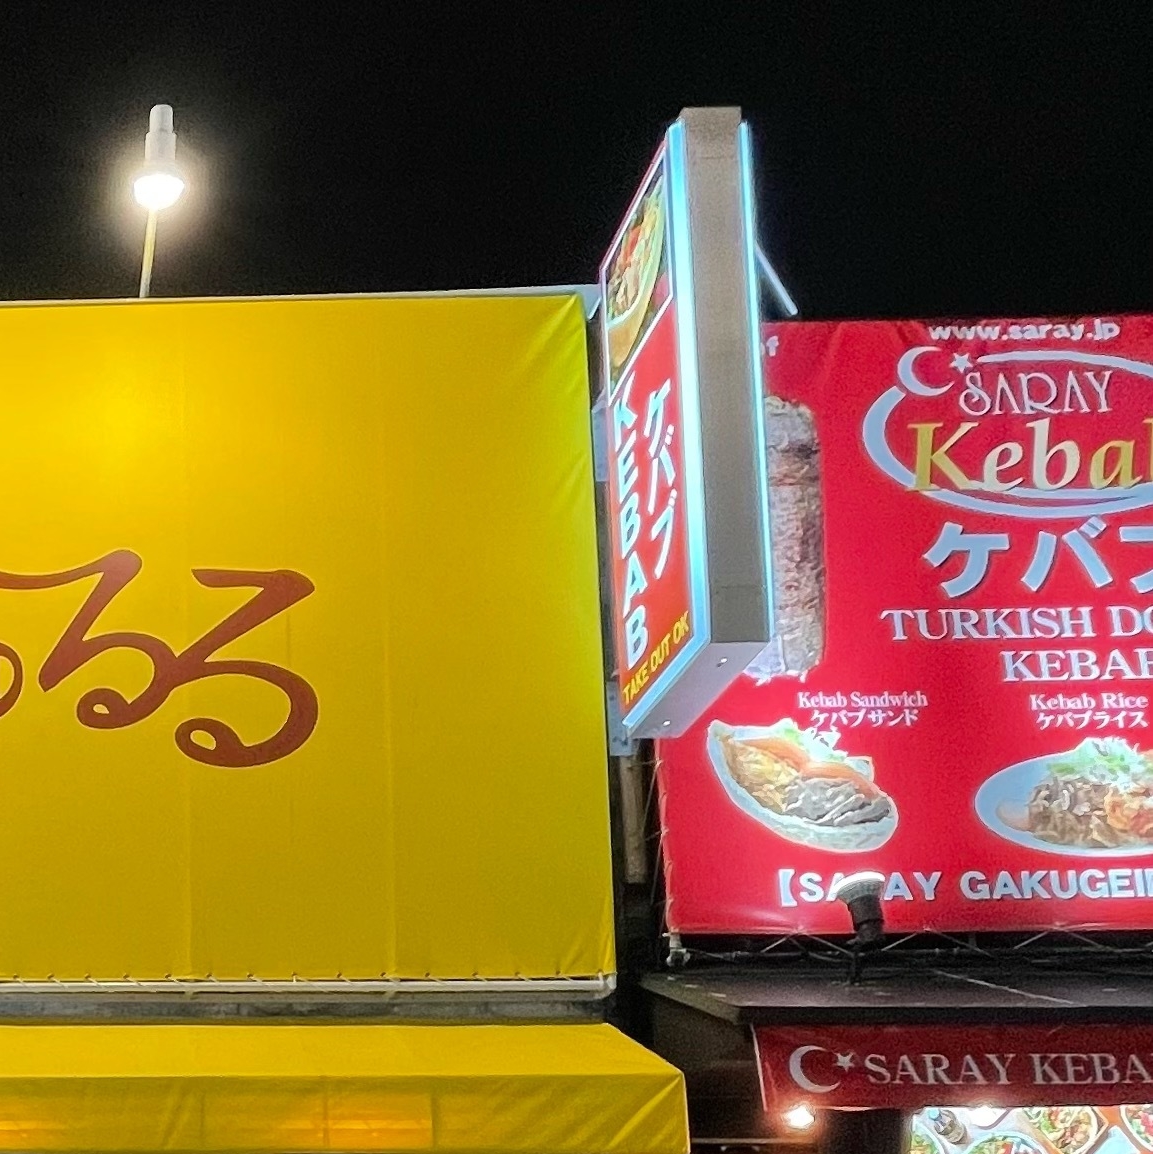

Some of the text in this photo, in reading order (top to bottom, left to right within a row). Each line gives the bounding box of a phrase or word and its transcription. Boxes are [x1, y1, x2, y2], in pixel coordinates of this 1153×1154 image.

[929, 319, 1120, 341] www.saray.jp
[958, 371, 1114, 416] SARAY
[643, 378, 677, 580] ケバブ
[614, 371, 649, 670] KEBAB
[880, 606, 1096, 641] TURKISH
[623, 610, 690, 705] TAKE OUT OK
[798, 690, 928, 708] Kebab Sandwich
[1029, 692, 1150, 710] Kebab Rice
[810, 708, 918, 728] ケバブサンド
[1036, 710, 1149, 731] ケバブライス
[864, 1052, 1153, 1085] SARAY KEBA
